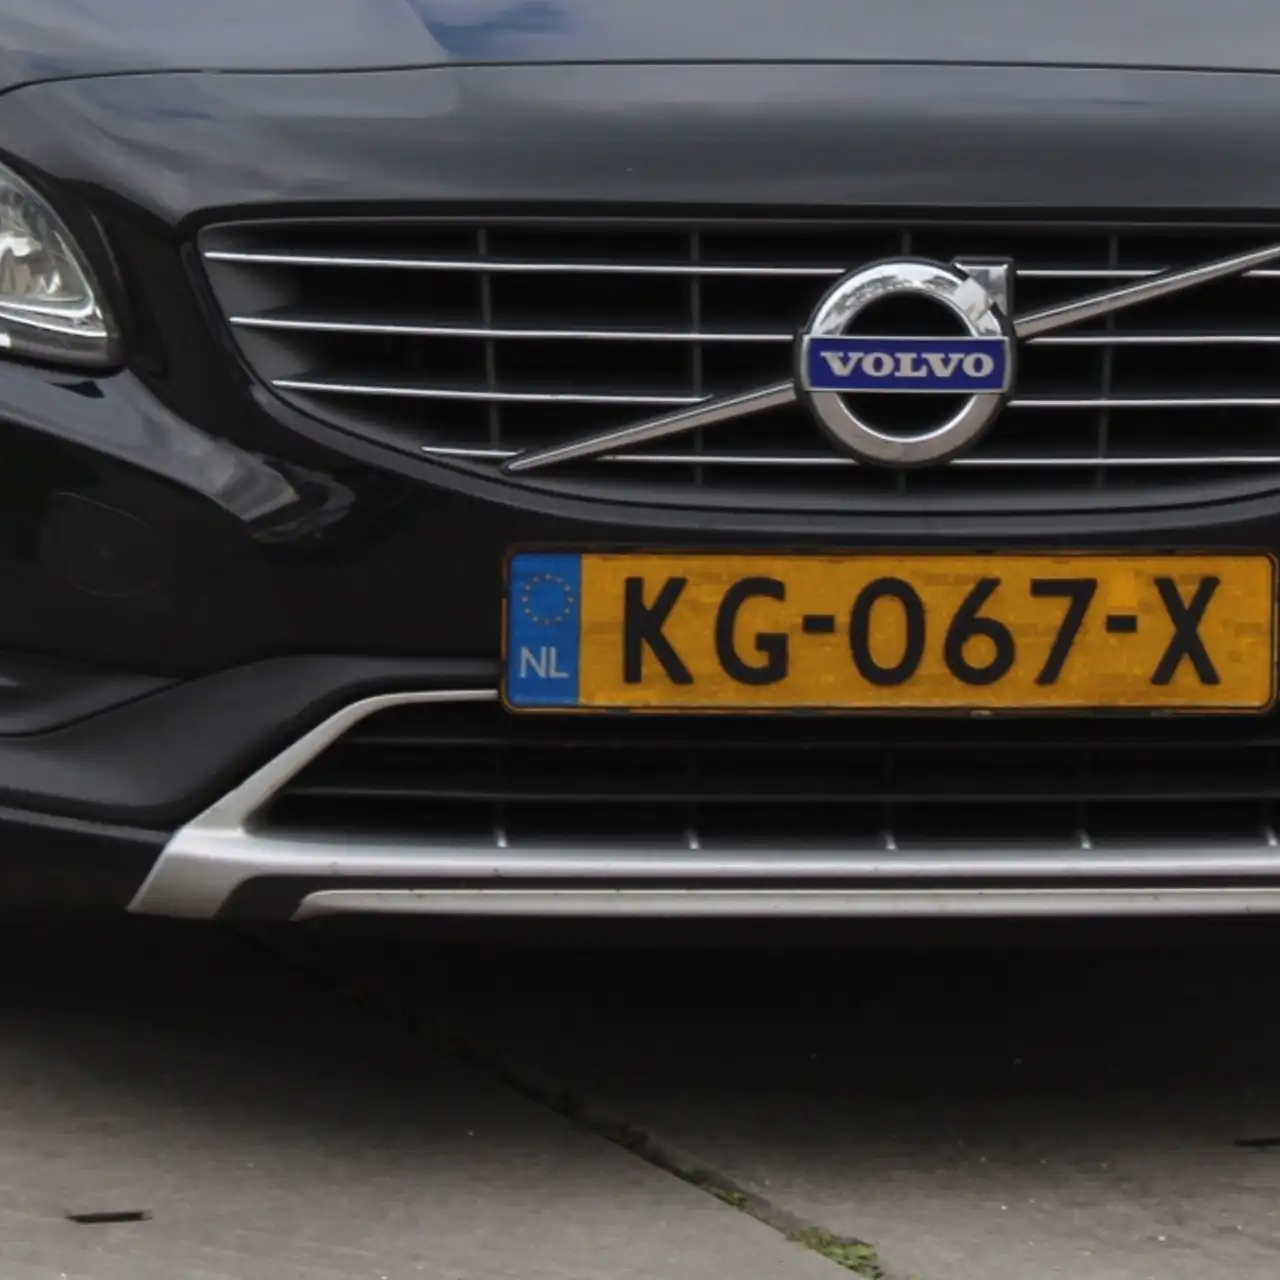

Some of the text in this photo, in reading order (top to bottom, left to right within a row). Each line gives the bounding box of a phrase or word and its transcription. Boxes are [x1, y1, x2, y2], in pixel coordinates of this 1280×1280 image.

[819, 351, 995, 378] VOLVO
[623, 576, 1222, 687] KG-067-X
[519, 646, 570, 680] NL
